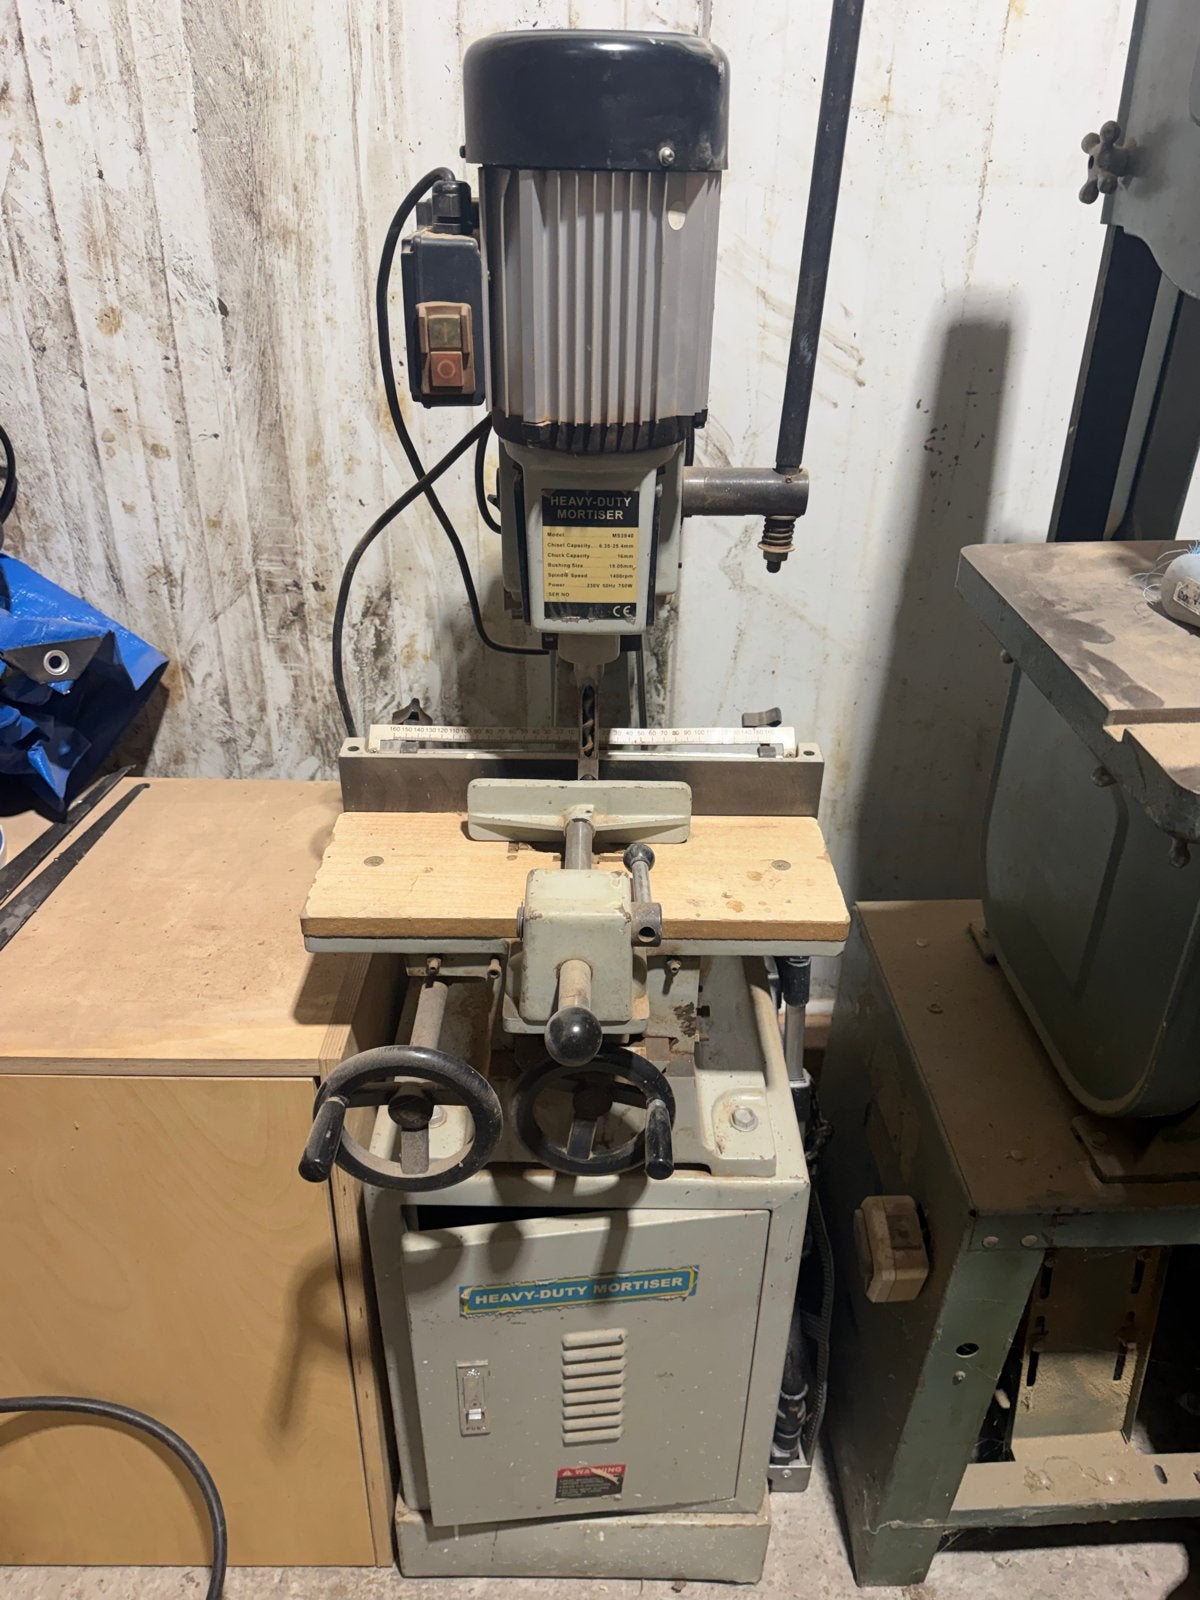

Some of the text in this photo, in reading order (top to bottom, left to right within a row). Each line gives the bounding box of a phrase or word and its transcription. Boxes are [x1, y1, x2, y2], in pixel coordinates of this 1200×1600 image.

[550, 496, 632, 507] HEAVY-DUTY
[557, 510, 624, 520] MORTISER
[475, 1277, 683, 1305] HEAVY-DUTY MORTISER
[575, 1465, 622, 1475] WAING
